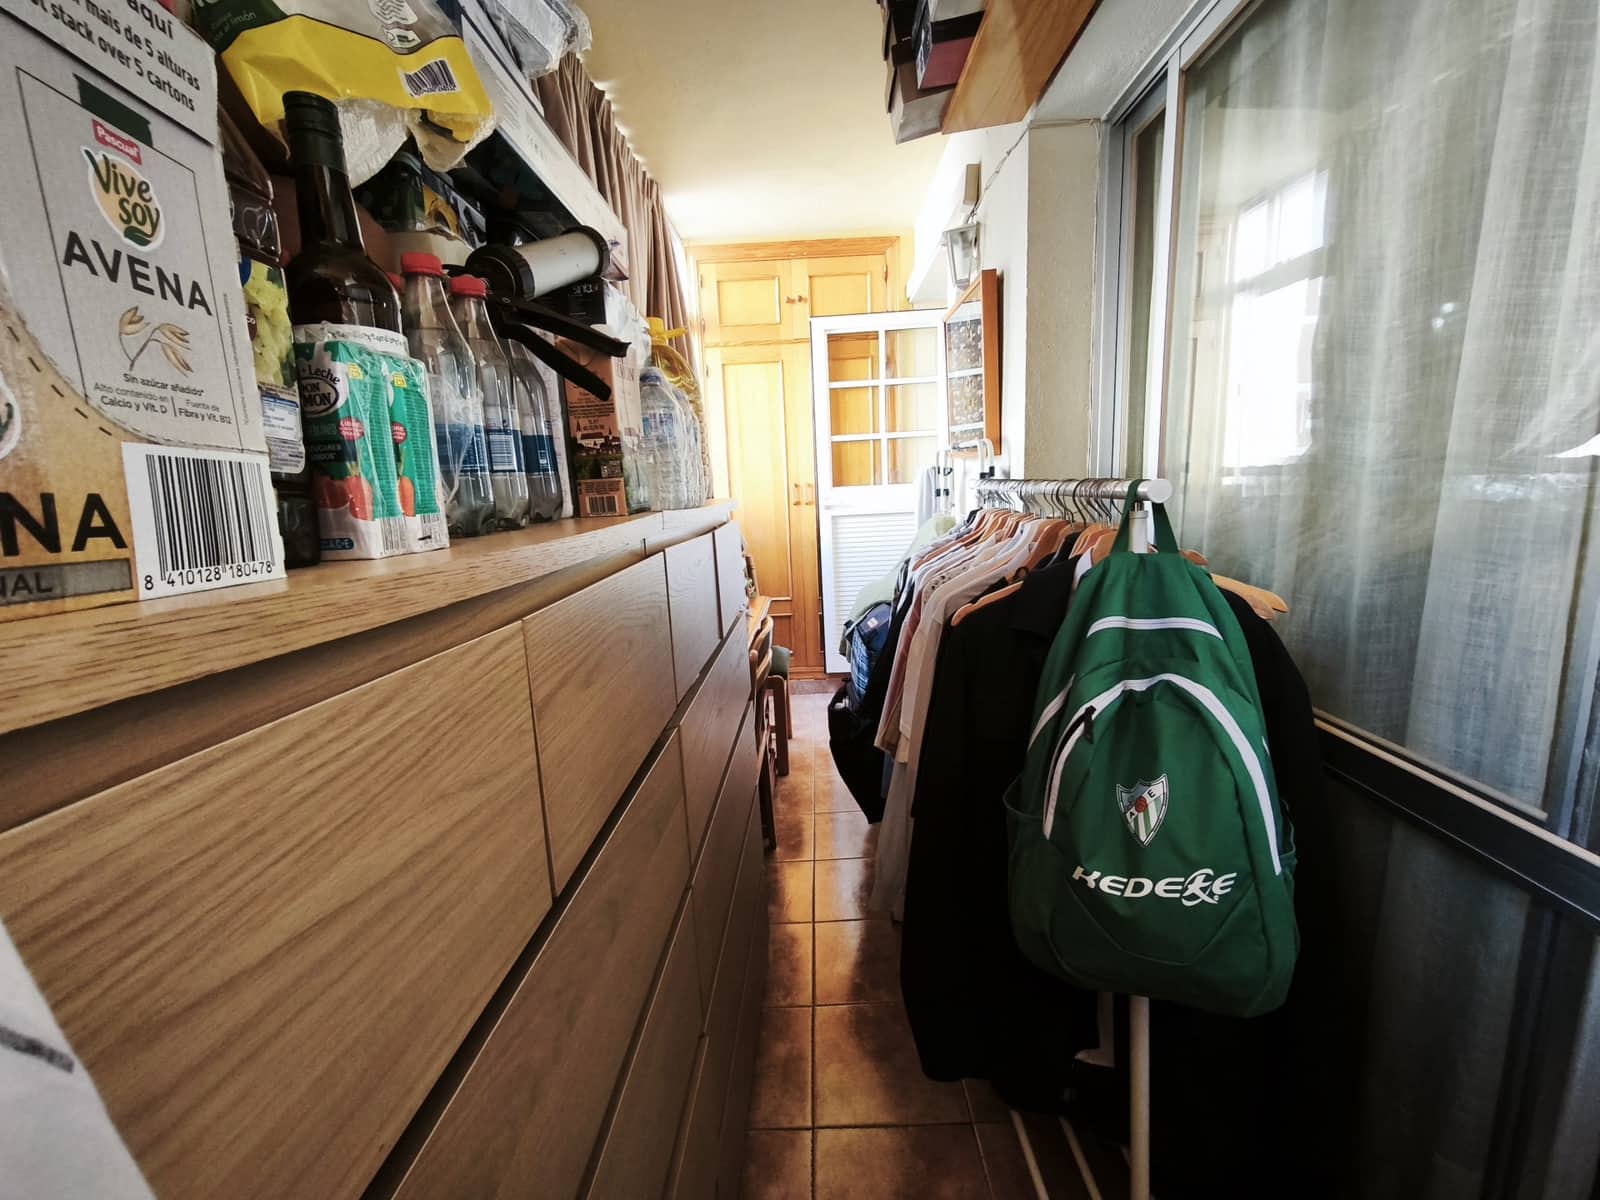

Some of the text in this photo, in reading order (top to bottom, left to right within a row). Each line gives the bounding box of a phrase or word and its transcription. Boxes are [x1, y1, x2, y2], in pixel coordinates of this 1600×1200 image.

[50, 2, 195, 112] stack over 5 cartons
[124, 25, 142, 50] de
[145, 38, 154, 57] 5
[157, 49, 201, 91] alturas
[96, 125, 139, 158] Pascual
[84, 149, 152, 203] Vive
[63, 230, 212, 316] AVENA
[123, 373, 139, 385] Sin
[308, 364, 340, 385] Leche
[303, 382, 320, 393] ON
[100, 395, 133, 409] Calcio
[134, 402, 140, 412] y
[160, 404, 168, 414] D
[303, 392, 331, 406] MON
[178, 407, 199, 419] Fibra
[144, 560, 273, 591] 8 410128 180478
[1147, 789, 1156, 798] E
